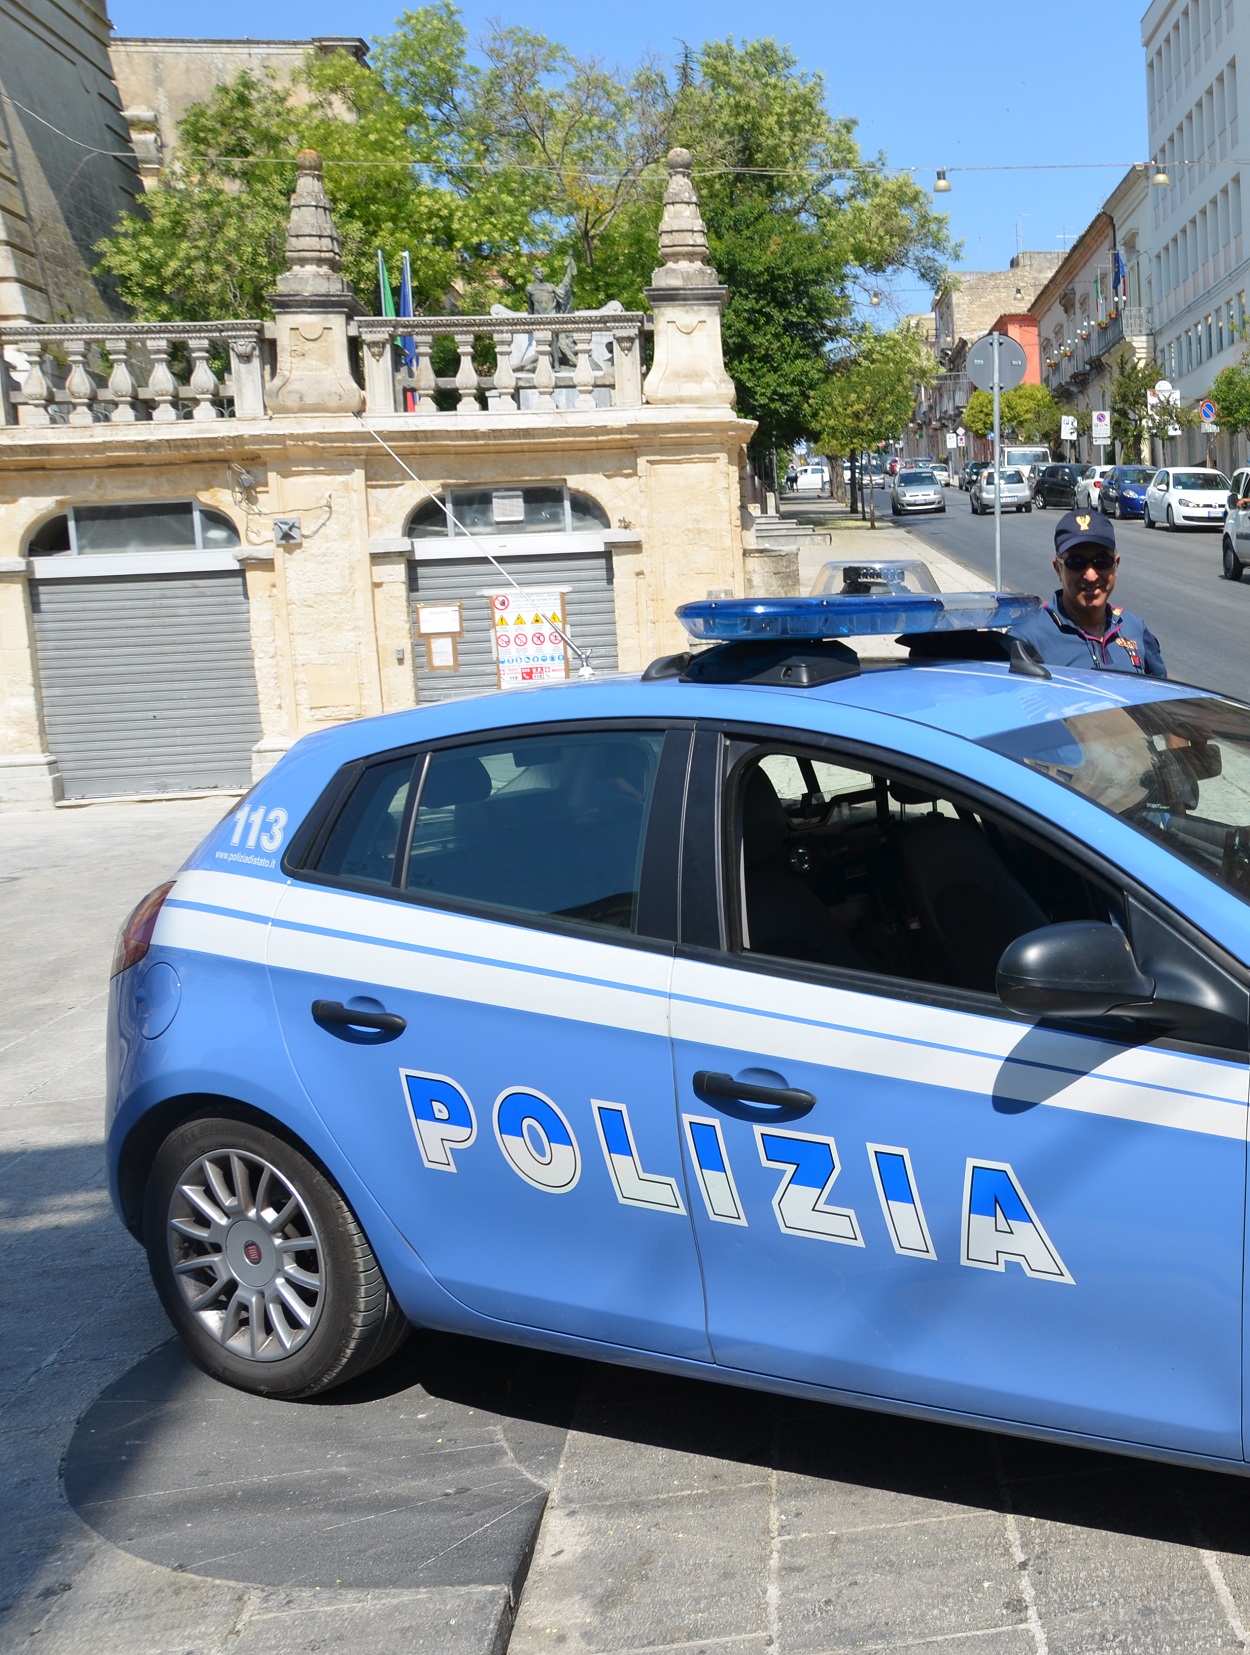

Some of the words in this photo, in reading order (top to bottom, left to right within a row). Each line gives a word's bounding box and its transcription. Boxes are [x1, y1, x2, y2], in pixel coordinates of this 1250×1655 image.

[230, 804, 289, 853] 113
[214, 850, 277, 869] www.poliziadistato.it
[398, 1067, 1076, 1286] POLIZIA
